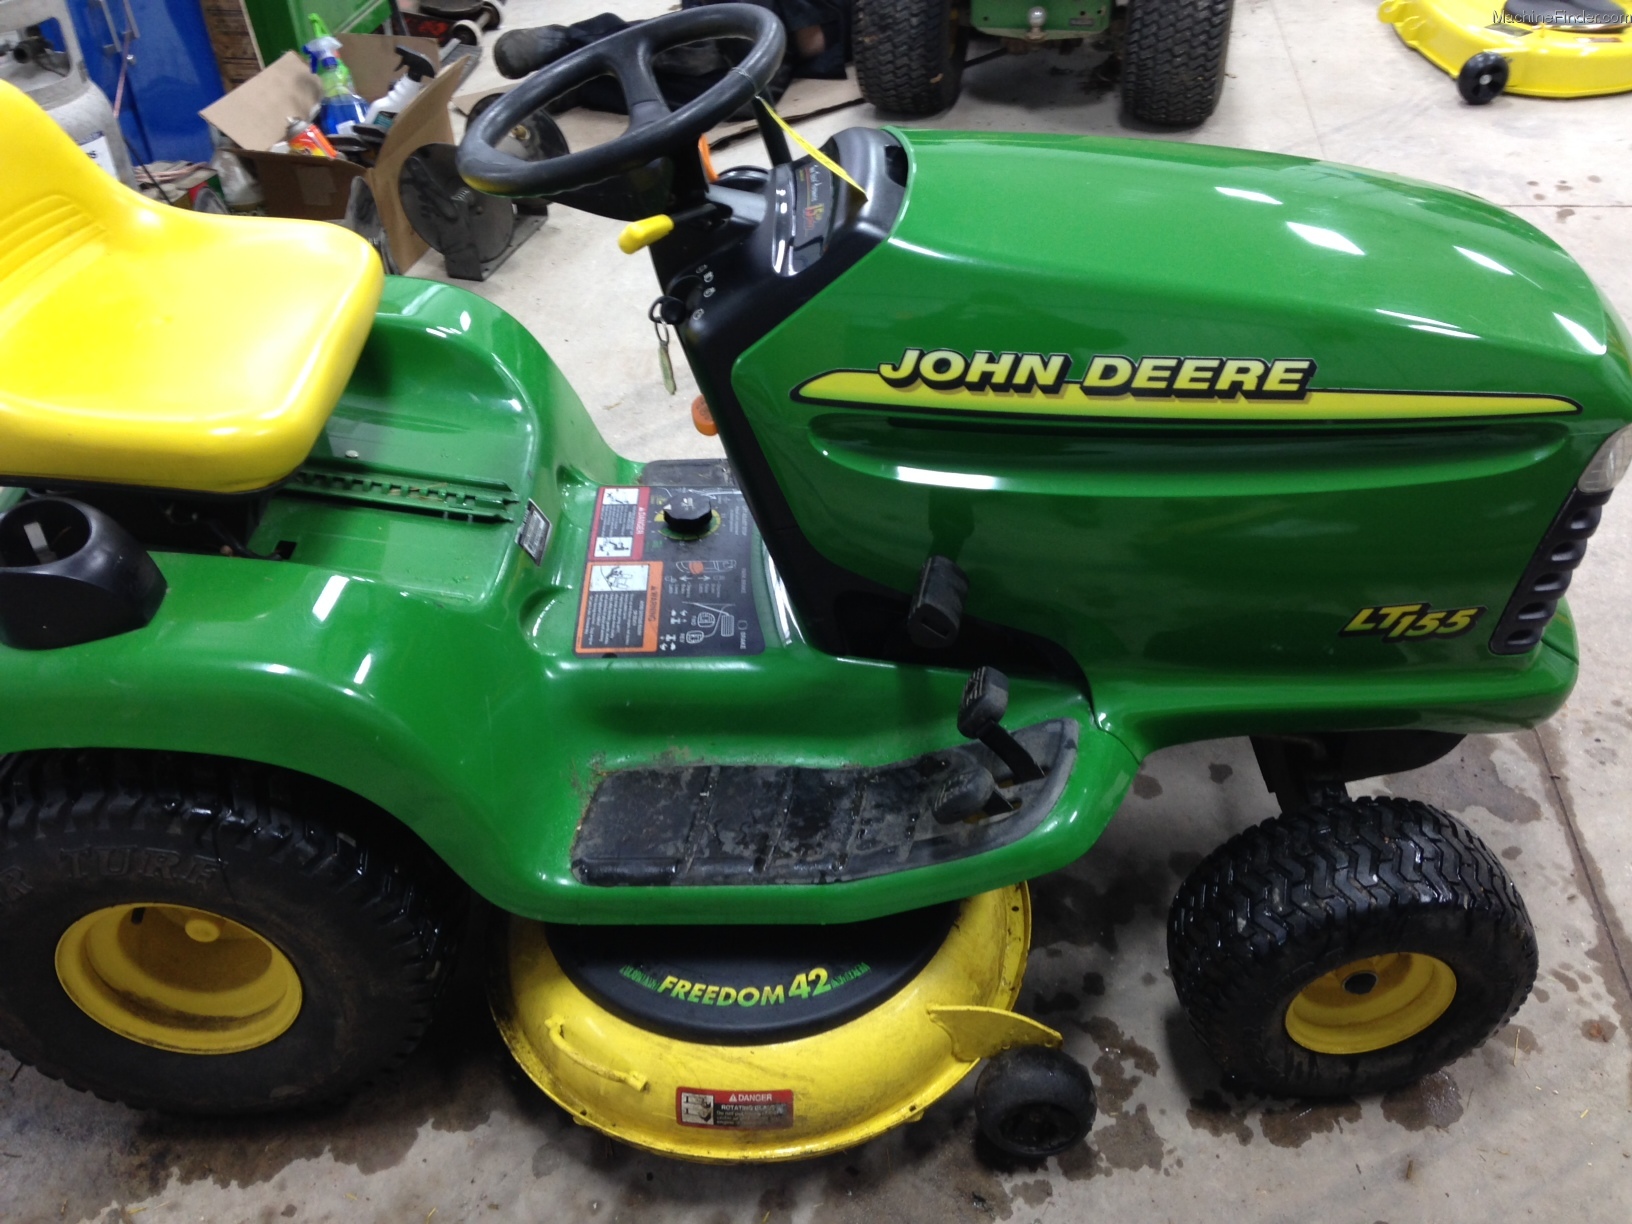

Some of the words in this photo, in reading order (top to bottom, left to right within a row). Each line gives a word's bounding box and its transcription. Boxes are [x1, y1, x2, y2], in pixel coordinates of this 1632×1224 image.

[878, 347, 1072, 394] JOHN
[1079, 354, 1318, 399] DEERE
[648, 590, 658, 622] WARNING
[1341, 602, 1486, 641] LT155
[59, 844, 228, 884] TURF
[657, 975, 785, 1007] FREEDOM
[788, 967, 833, 999] 42
[738, 1093, 773, 1103] DANGER
